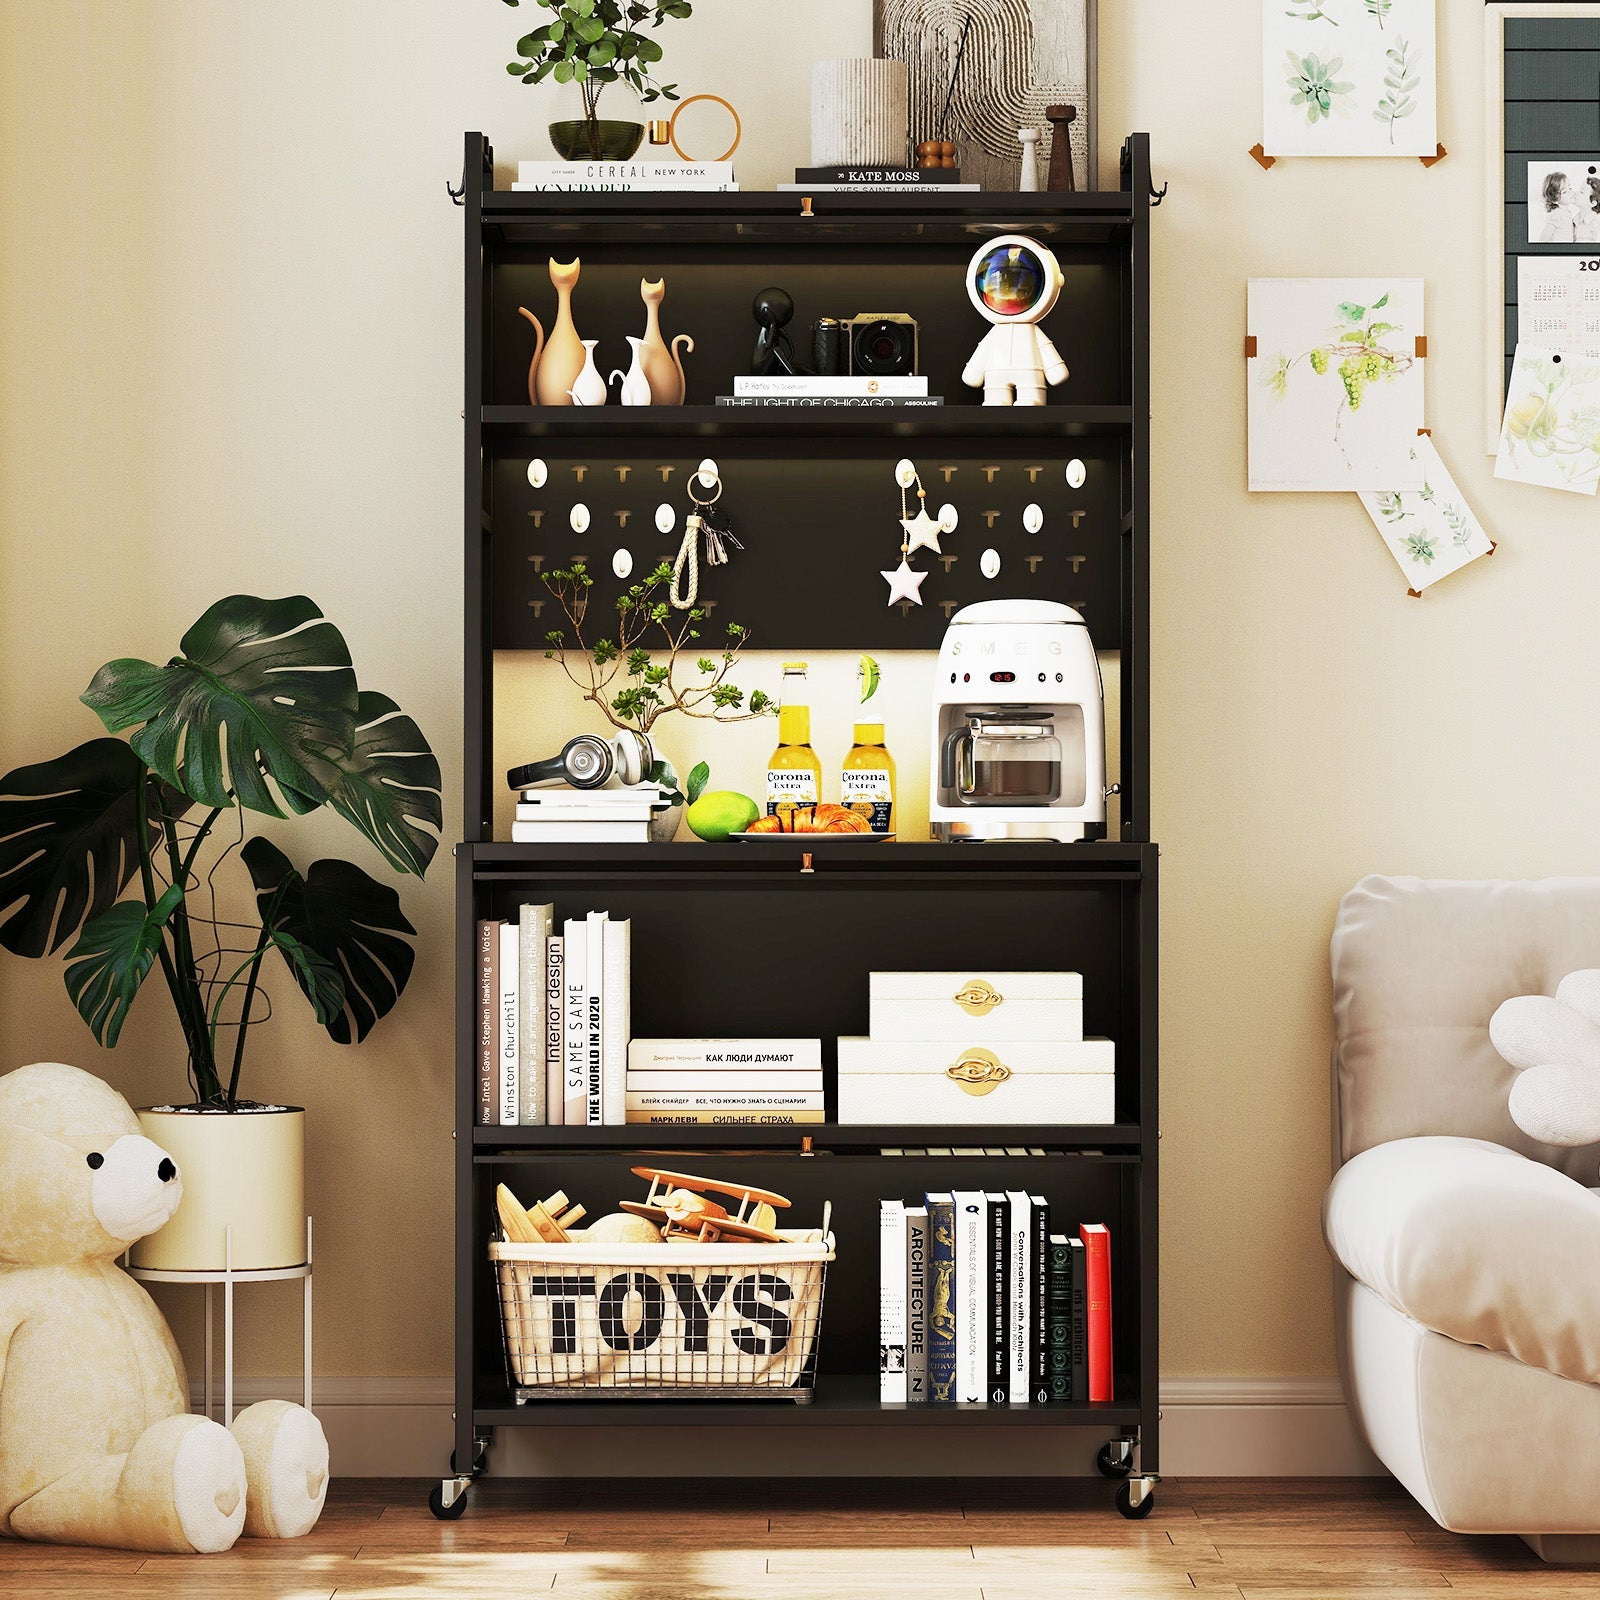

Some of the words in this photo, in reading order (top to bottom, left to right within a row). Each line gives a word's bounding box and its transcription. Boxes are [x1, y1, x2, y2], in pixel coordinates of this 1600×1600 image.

[587, 165, 646, 178] CEREAL
[848, 171, 882, 182] KATE
[884, 171, 920, 182] MOSS
[723, 398, 754, 406] THE
[826, 398, 894, 406] CHICAGO
[767, 771, 811, 782] Corona
[842, 771, 886, 782] Corona
[528, 910, 537, 937] house
[482, 925, 491, 953] Voice
[527, 942, 537, 958] the
[528, 964, 537, 975] in
[547, 943, 564, 999] design
[482, 966, 493, 1005] Hawking
[569, 984, 583, 1030] SAME
[589, 996, 600, 1030] 2020
[482, 1008, 493, 1046] Stephen
[505, 991, 515, 1059] Churchill
[547, 1004, 560, 1063] Interior
[529, 1044, 537, 1055] an
[589, 1033, 600, 1047] IN
[482, 1050, 491, 1071] Gave
[569, 1041, 583, 1088] SAME
[705, 1054, 724, 1062] КАК
[725, 1054, 753, 1063] ЛЮДИ
[754, 1054, 794, 1063] ДУМАЮТ
[589, 1050, 600, 1098] WORLD
[482, 1077, 491, 1103] Intel
[505, 1066, 515, 1119] Winston
[527, 1086, 537, 1098] to
[482, 1106, 491, 1124] How
[527, 1102, 537, 1120] How
[589, 1101, 600, 1123] THE
[650, 1116, 674, 1124] МАРК
[674, 1116, 698, 1124] ЛЕВИ
[712, 1115, 757, 1124] СИЛЬНЕЕ
[760, 1115, 794, 1124] СТРАХА
[968, 1221, 977, 1262] ESSENTIALS
[968, 1263, 977, 1273] OF
[1018, 1231, 1026, 1299] Conversations
[911, 1226, 924, 1355] ARCHITECTURE
[968, 1273, 977, 1296] VISUAL
[532, 1272, 795, 1355] TOYS
[1017, 1301, 1025, 1322] with
[968, 1297, 977, 1356] COMMUNICATION
[1016, 1324, 1025, 1372] Architects
